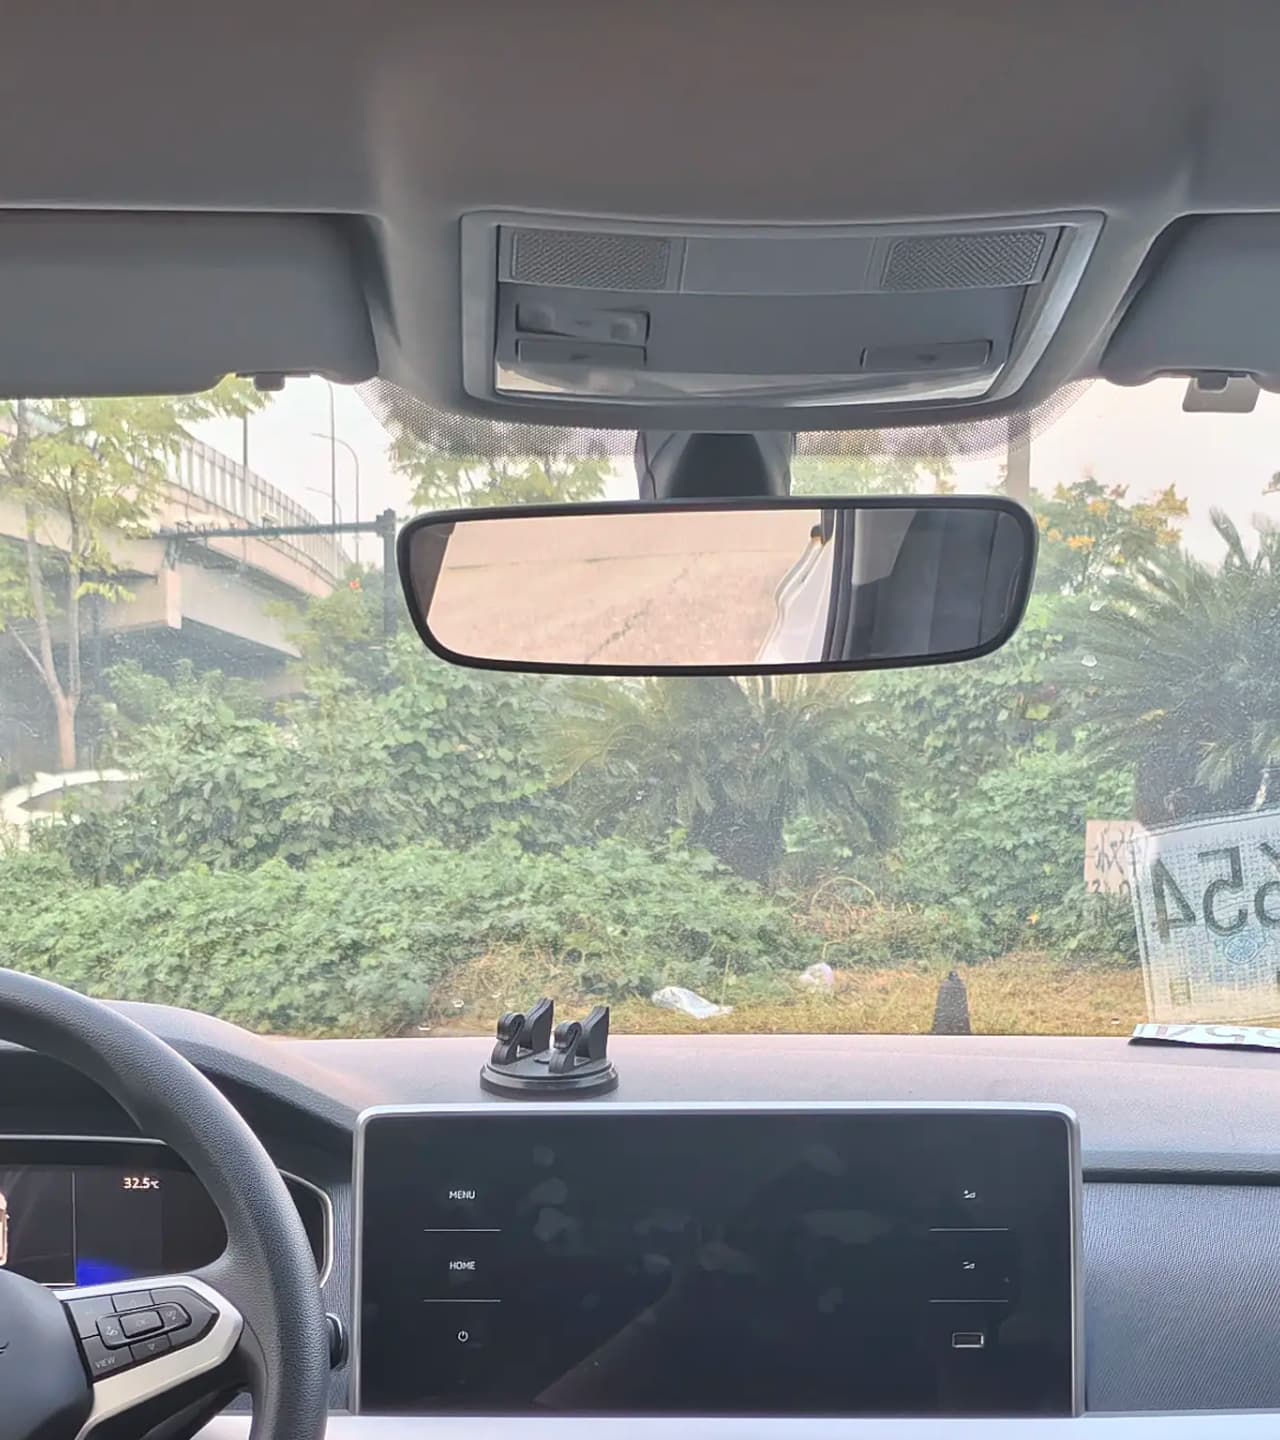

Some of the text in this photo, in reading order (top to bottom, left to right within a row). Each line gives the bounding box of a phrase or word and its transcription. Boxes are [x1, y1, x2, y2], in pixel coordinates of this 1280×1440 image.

[448, 1190, 476, 1199] MENU
[449, 1260, 476, 1270] HOME
[94, 1356, 116, 1369] VIEW
